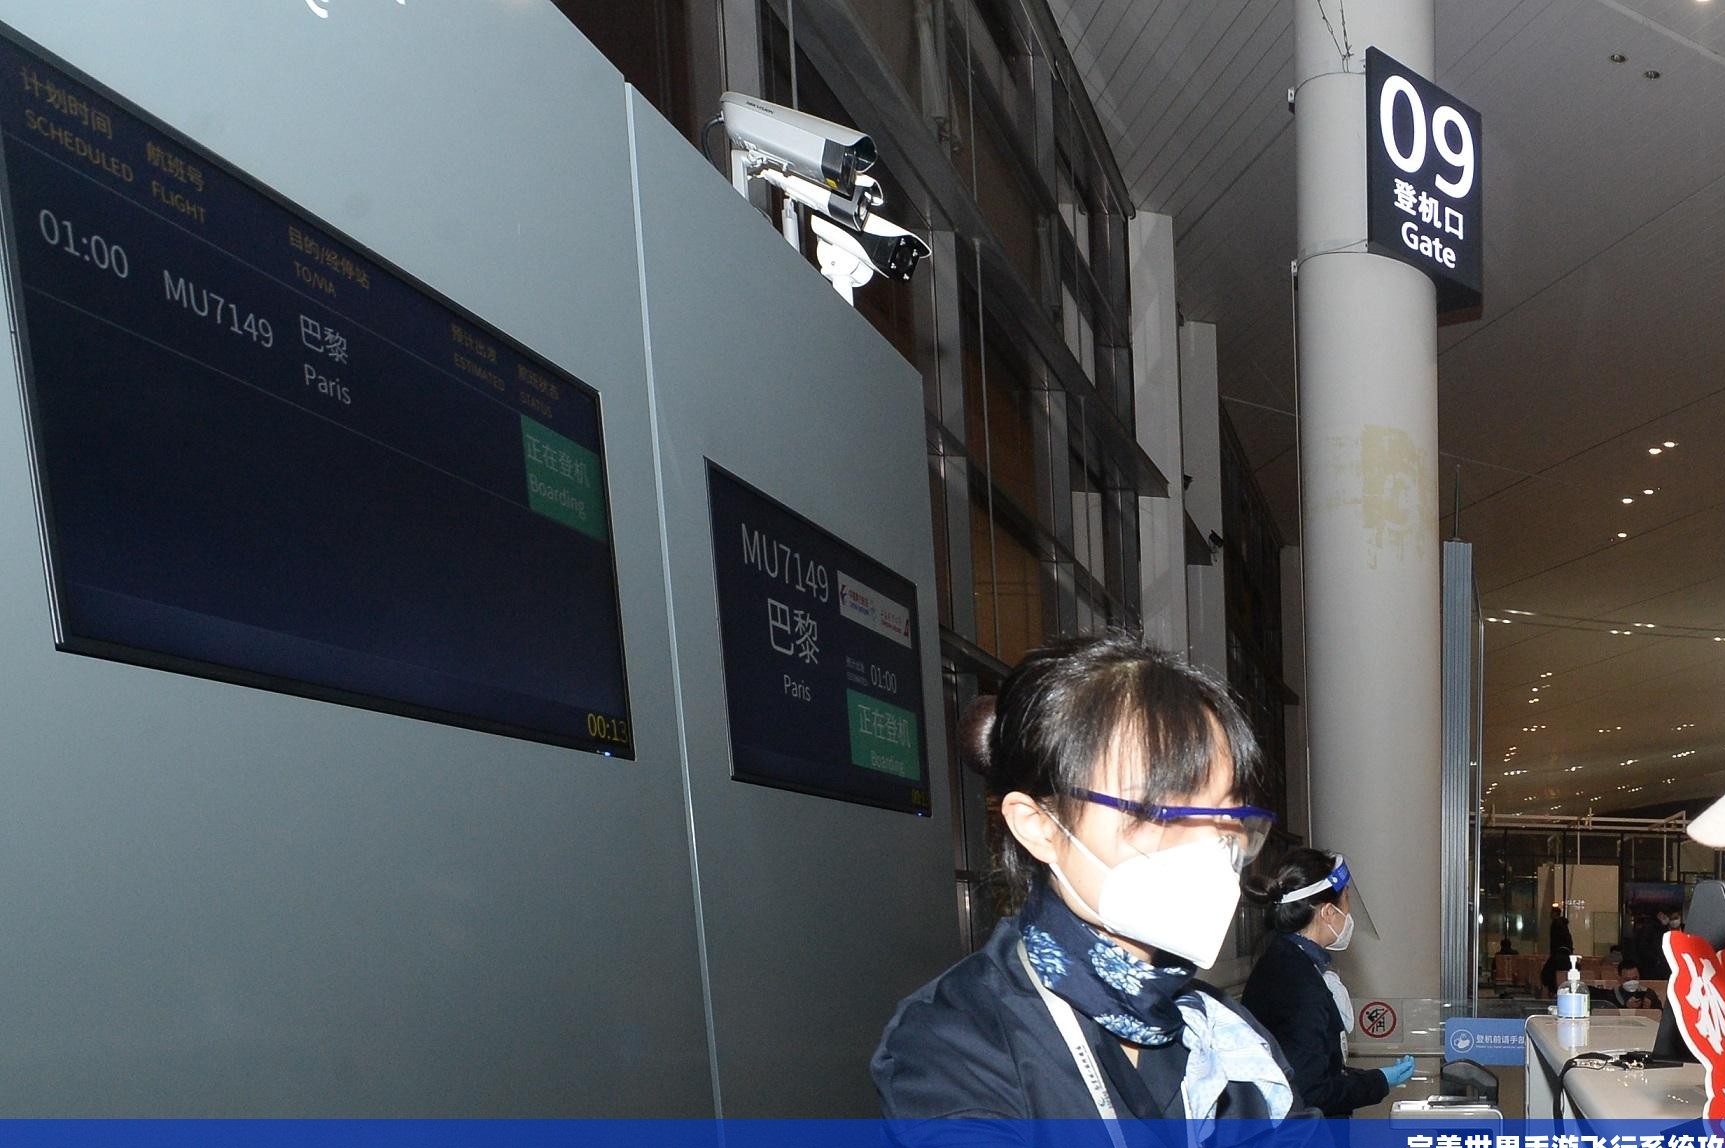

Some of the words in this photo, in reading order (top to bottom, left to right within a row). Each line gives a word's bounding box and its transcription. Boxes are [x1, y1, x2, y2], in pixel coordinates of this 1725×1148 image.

[20, 67, 113, 140] 计划时间
[146, 140, 205, 192] 航班号
[1380, 75, 1475, 199] 09
[24, 109, 134, 183] SCHEDULED
[151, 180, 206, 224] FLIGHT
[294, 260, 337, 297] TO/VIA
[1393, 178, 1464, 240] 登机口
[1401, 221, 1457, 269] Gate
[40, 208, 129, 278] 01:00
[162, 268, 274, 349] MU7149
[299, 313, 349, 366] 巴黎
[526, 434, 591, 489] 正在登机
[303, 364, 351, 405] Paris
[529, 470, 587, 519] Boarding
[741, 523, 829, 604] MU7149
[767, 597, 820, 665] 巴黎
[783, 674, 812, 702] Paris
[870, 664, 897, 694] 01:00
[587, 712, 628, 744] 00:13
[858, 704, 911, 749] 正在登机
